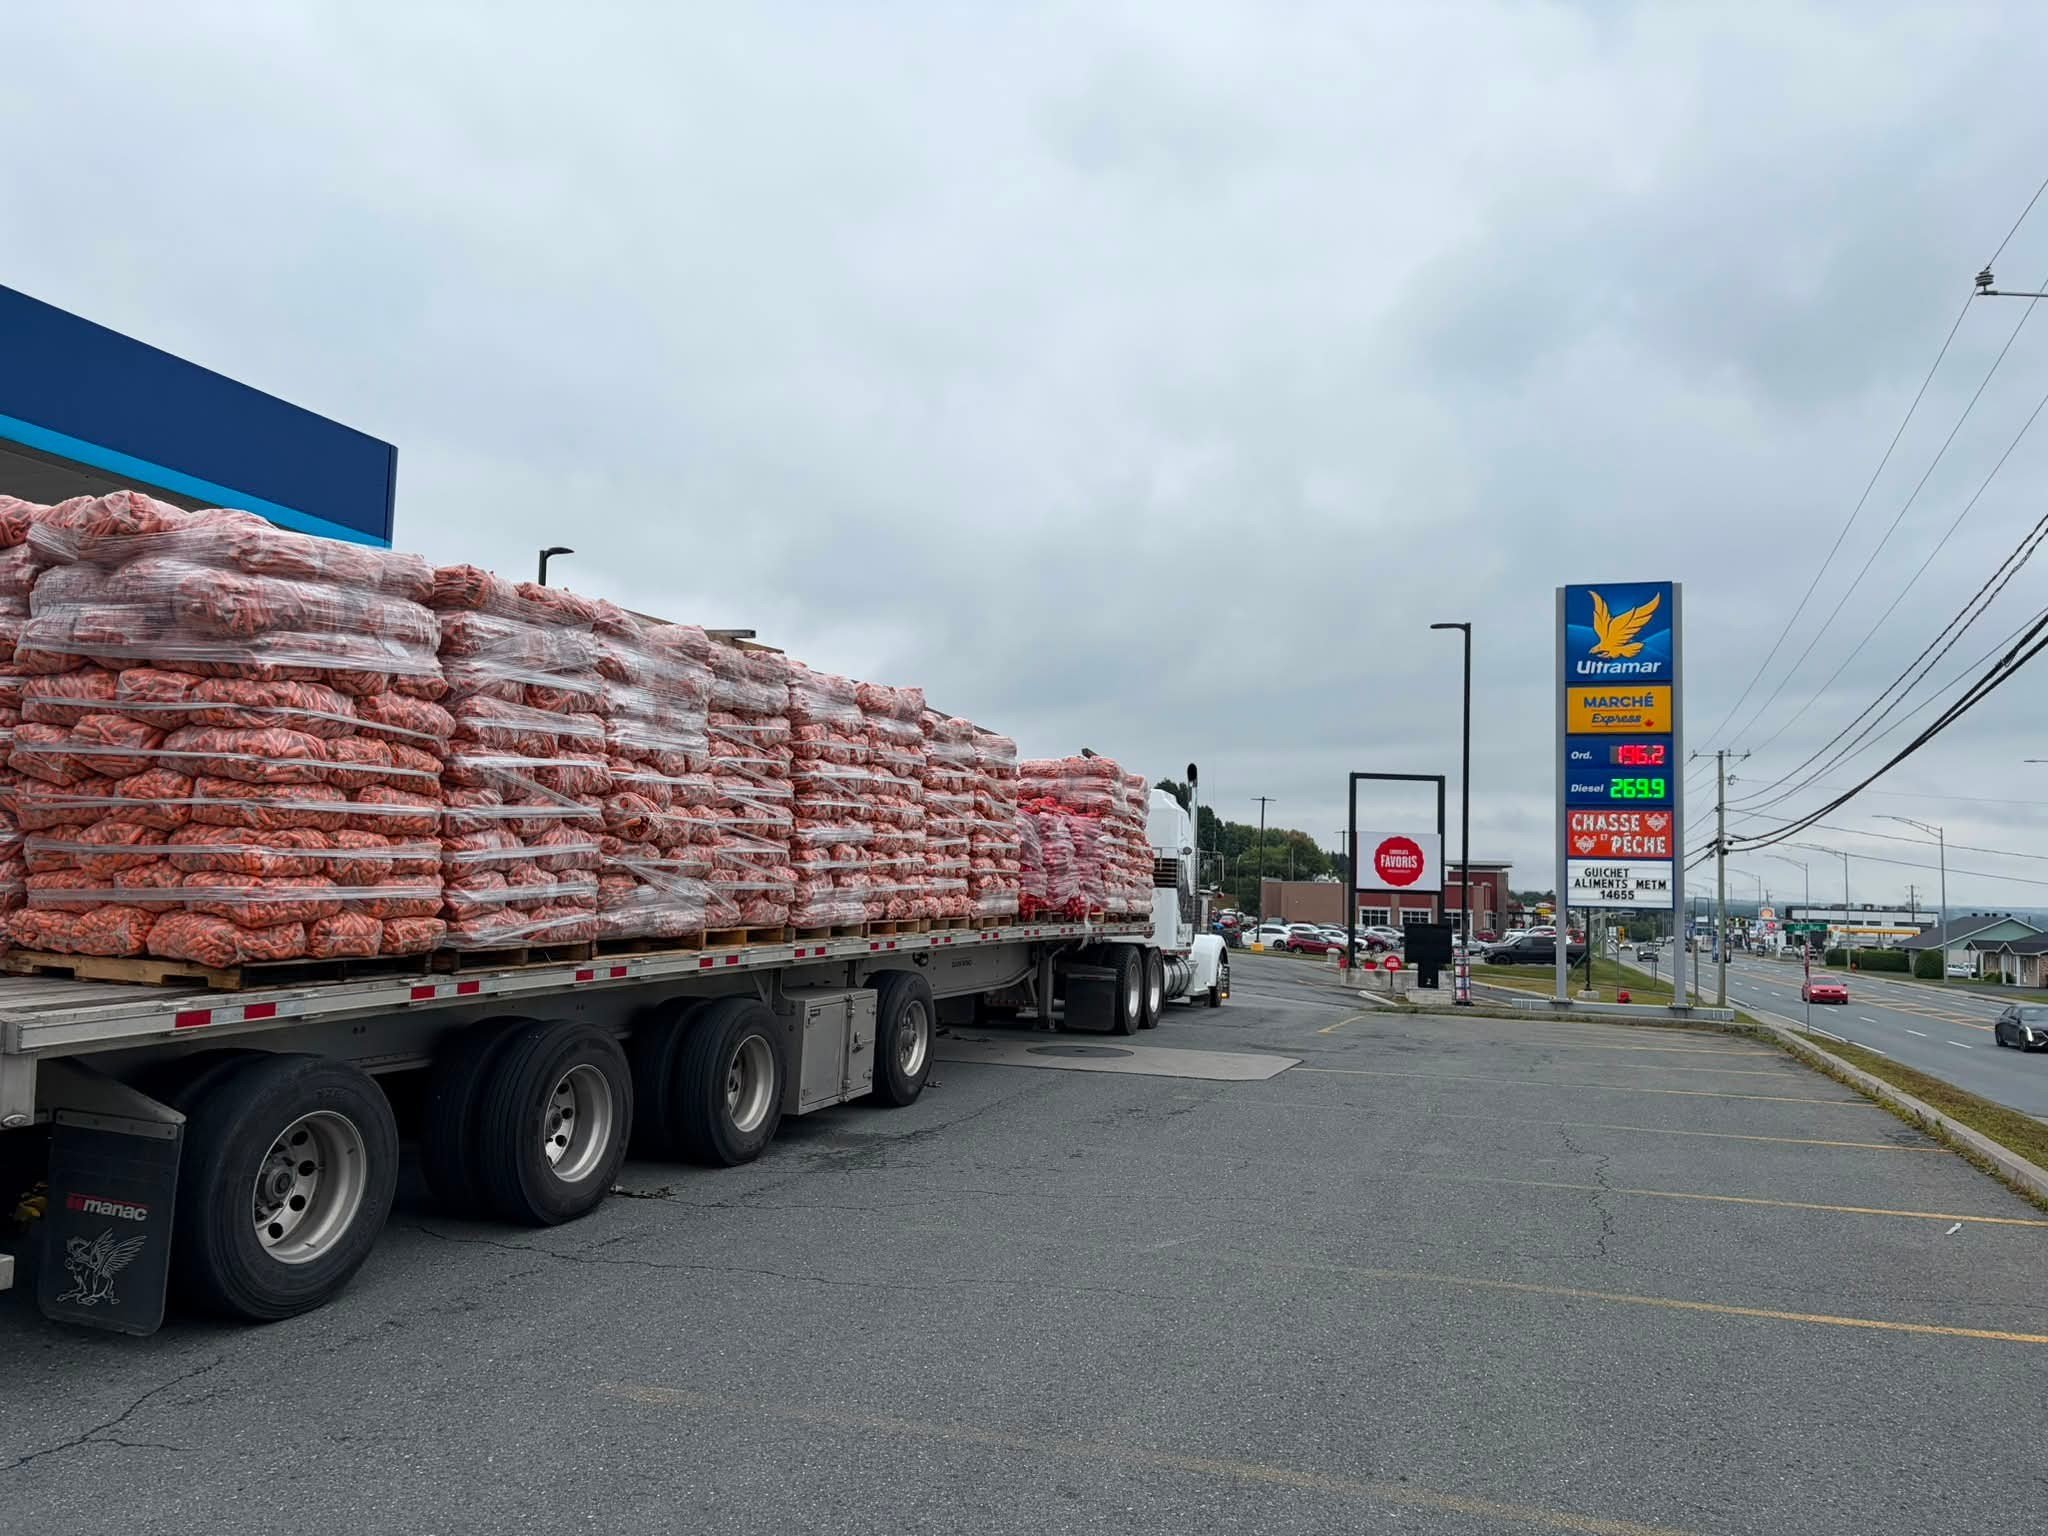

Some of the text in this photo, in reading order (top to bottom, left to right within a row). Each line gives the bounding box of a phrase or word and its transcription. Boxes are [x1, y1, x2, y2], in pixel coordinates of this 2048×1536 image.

[1576, 660, 1662, 675] Ultramar
[1583, 692, 1654, 708] MARCHÉ
[1591, 713, 1641, 726] Express
[1571, 751, 1592, 760] Ord.
[1570, 778, 1665, 799] Diesel 269.9
[1572, 814, 1640, 832] CHASSE
[1610, 832, 1666, 854] PÊCHE
[1380, 854, 1418, 869] FAVORIS
[1584, 867, 1629, 878] GUICHET
[1574, 878, 1666, 890] ALIMENTS METM
[1600, 890, 1634, 900] 14655
[83, 1197, 148, 1221] manac
